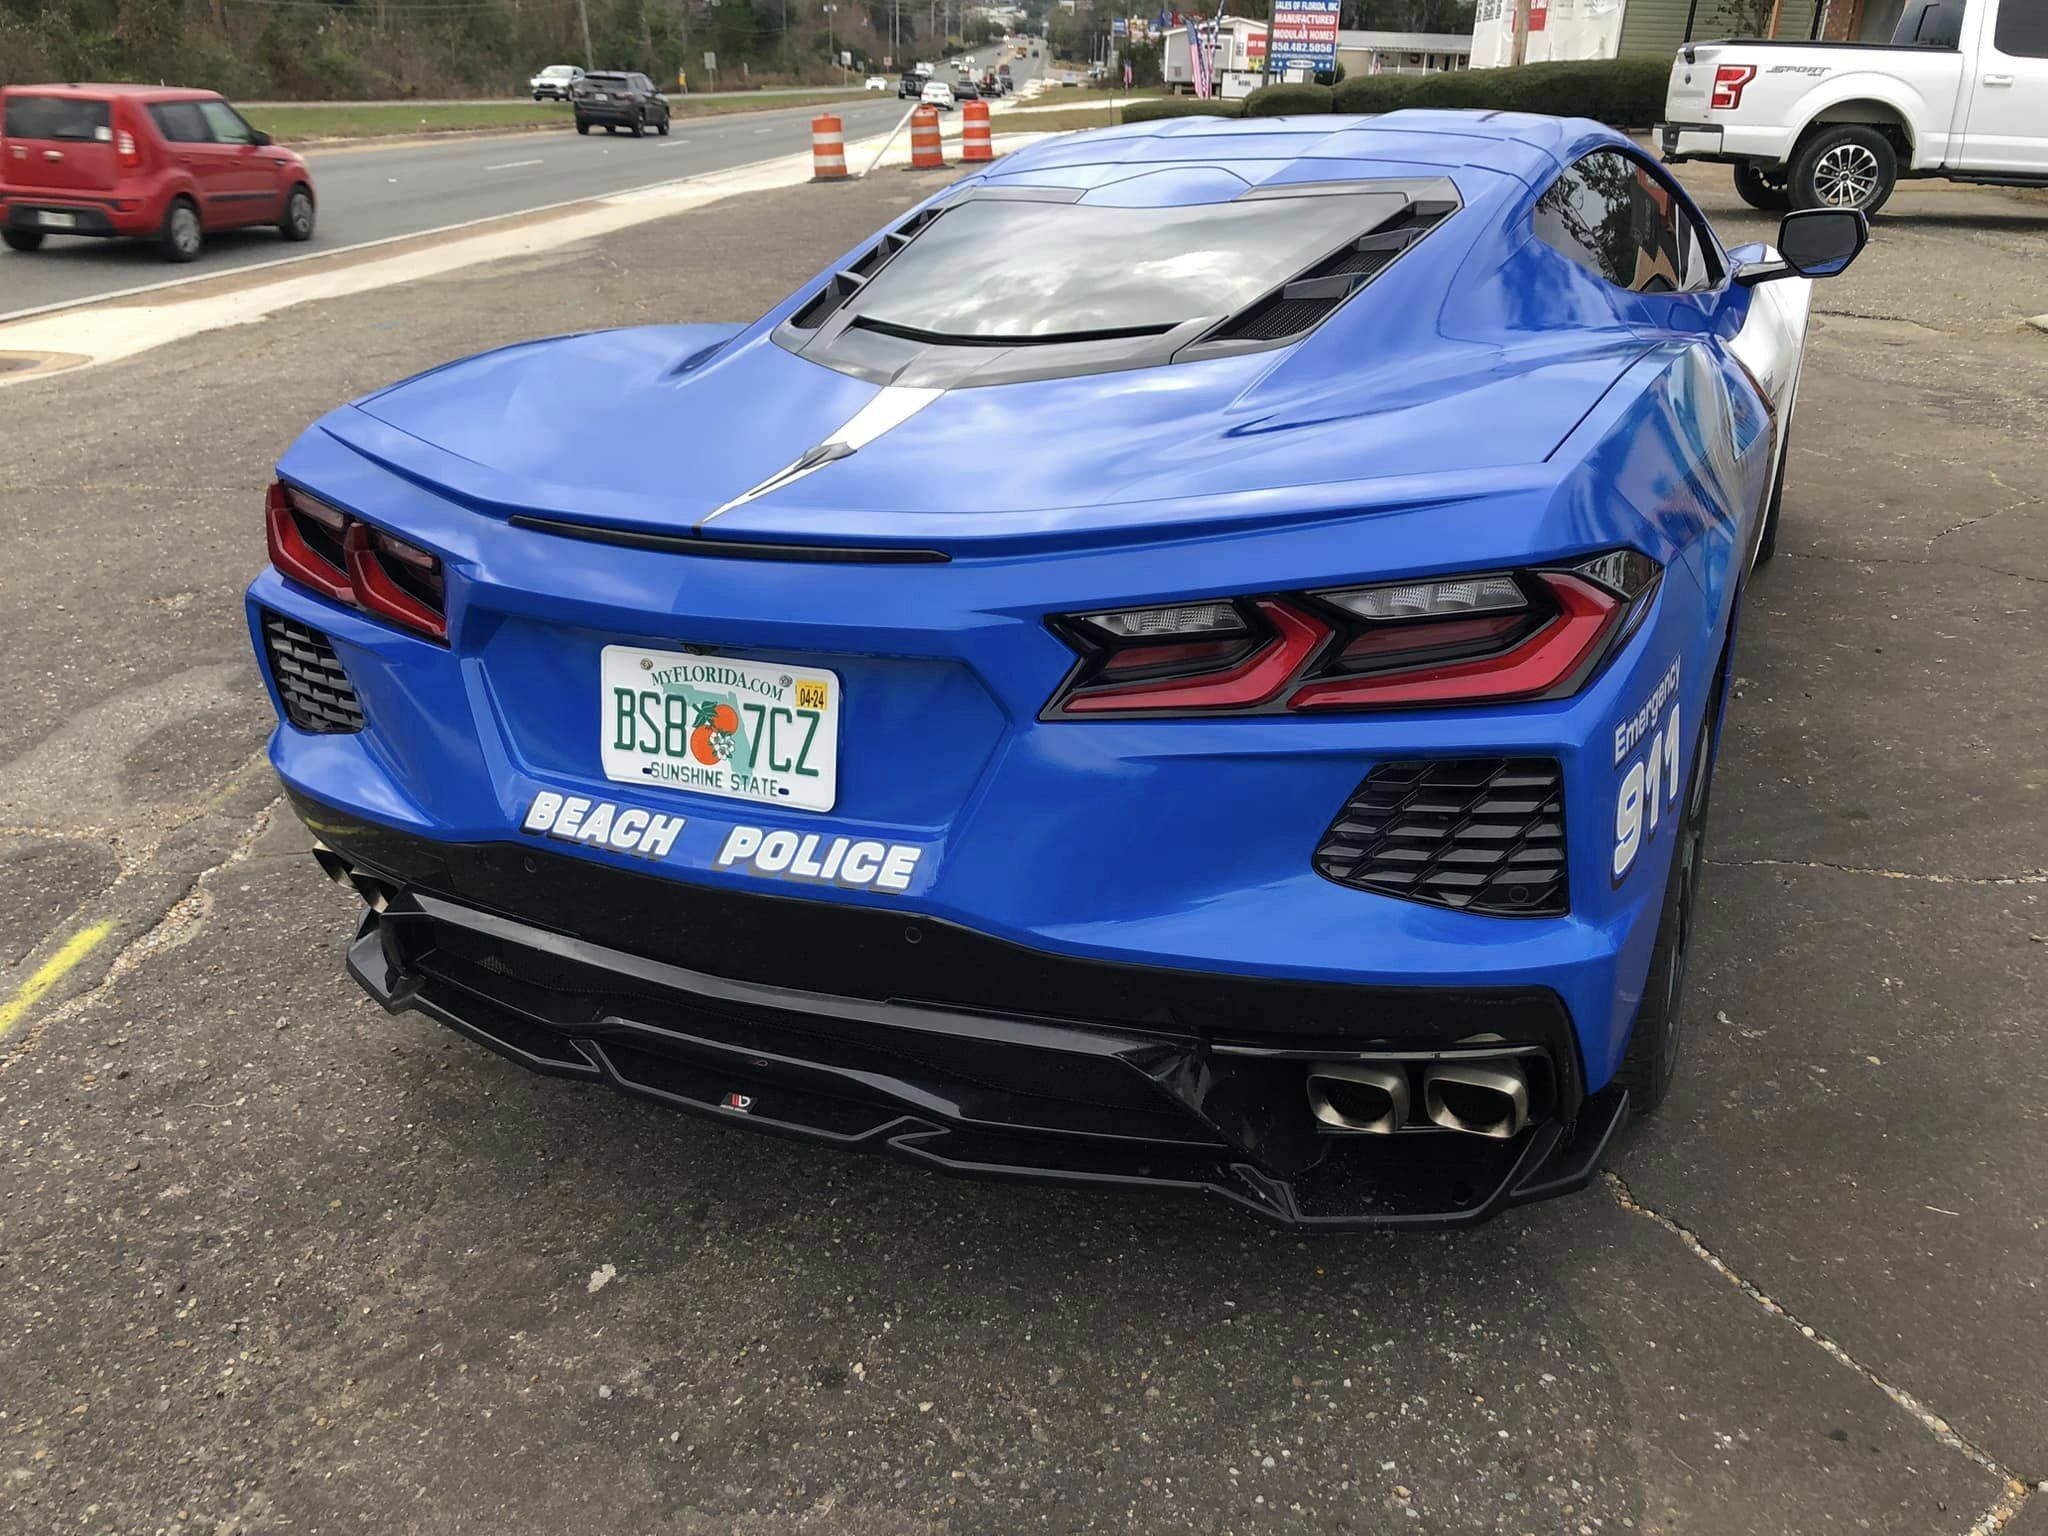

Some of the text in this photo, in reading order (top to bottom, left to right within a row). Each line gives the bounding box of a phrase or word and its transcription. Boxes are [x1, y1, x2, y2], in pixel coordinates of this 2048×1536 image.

[1293, 2, 1301, 10] OF
[1275, 13, 1335, 24] MANUFACTURED
[1273, 29, 1334, 40] MODULAR HOMES
[1271, 41, 1332, 53] 850.482.5056
[1766, 65, 1832, 73] SPORT
[652, 665, 785, 702] MYFLORIDA.COM
[800, 688, 824, 709] 04-24
[1615, 654, 1681, 763] Emergency
[650, 761, 778, 797] SUNSHINE STATE
[1614, 702, 1680, 876] 911
[523, 791, 922, 890] BEACH POLICE
